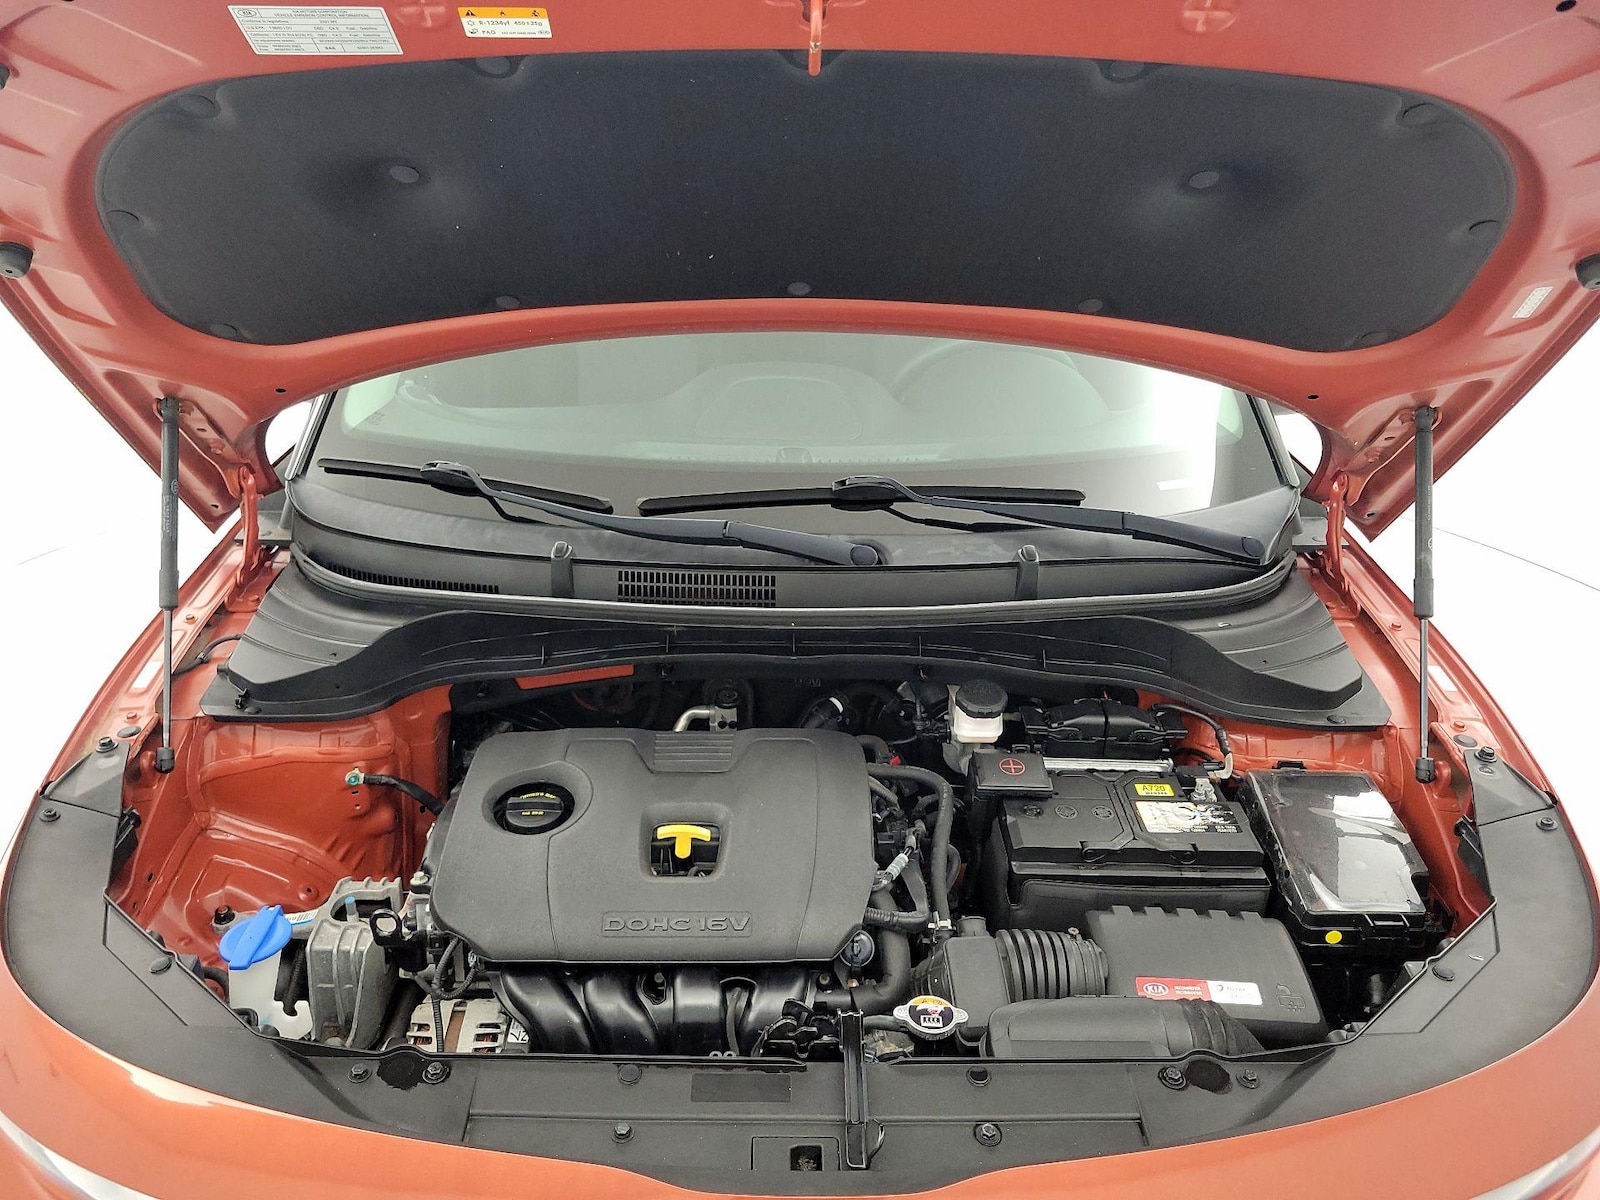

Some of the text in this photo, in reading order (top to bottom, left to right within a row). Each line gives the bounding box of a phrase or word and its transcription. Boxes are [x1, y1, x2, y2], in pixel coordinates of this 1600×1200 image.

[1142, 784, 1167, 792] A720
[604, 916, 751, 932] DOHC 16V
[1146, 985, 1165, 994] KIA
